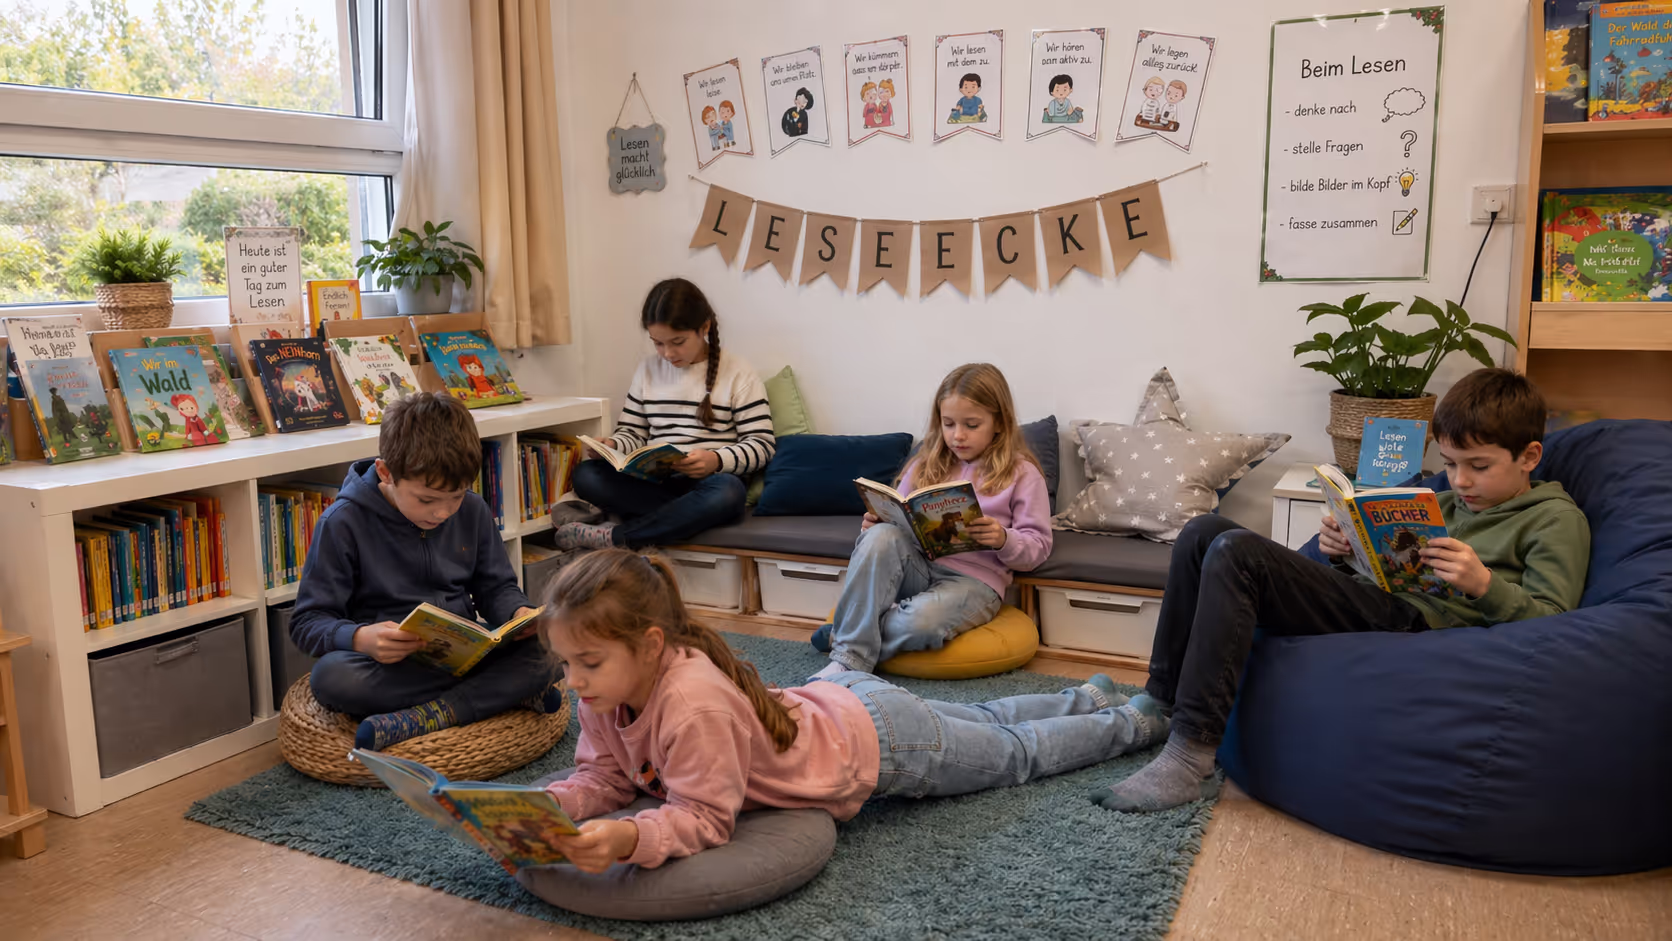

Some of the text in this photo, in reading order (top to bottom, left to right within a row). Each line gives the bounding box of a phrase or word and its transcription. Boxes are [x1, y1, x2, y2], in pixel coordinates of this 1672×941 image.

[1631, 20, 1658, 32] Wald
[951, 46, 964, 55] Wir
[1046, 42, 1060, 52] Wir
[1167, 46, 1188, 60] legen
[1301, 55, 1406, 79] Beim Lesen
[1294, 103, 1326, 117] denke
[1329, 100, 1357, 114] nach
[620, 136, 649, 151] Lesen
[1292, 141, 1321, 154] stelle
[1325, 140, 1363, 156] Fragen
[621, 149, 649, 164] macht
[1290, 179, 1314, 192] bilde
[1318, 178, 1348, 191] Bilder
[1351, 180, 1363, 190] im
[1367, 175, 1393, 192] Kopf
[1288, 217, 1317, 230] fasse
[1320, 218, 1378, 229] zusammen
[711, 196, 1149, 270] LESEECKE
[239, 243, 287, 257] Heute ist
[241, 260, 287, 277] ein guter
[244, 278, 287, 294] Tag zum
[249, 294, 286, 308] Lesen
[138, 369, 192, 395] Wald
[1380, 430, 1407, 441] Lesen
